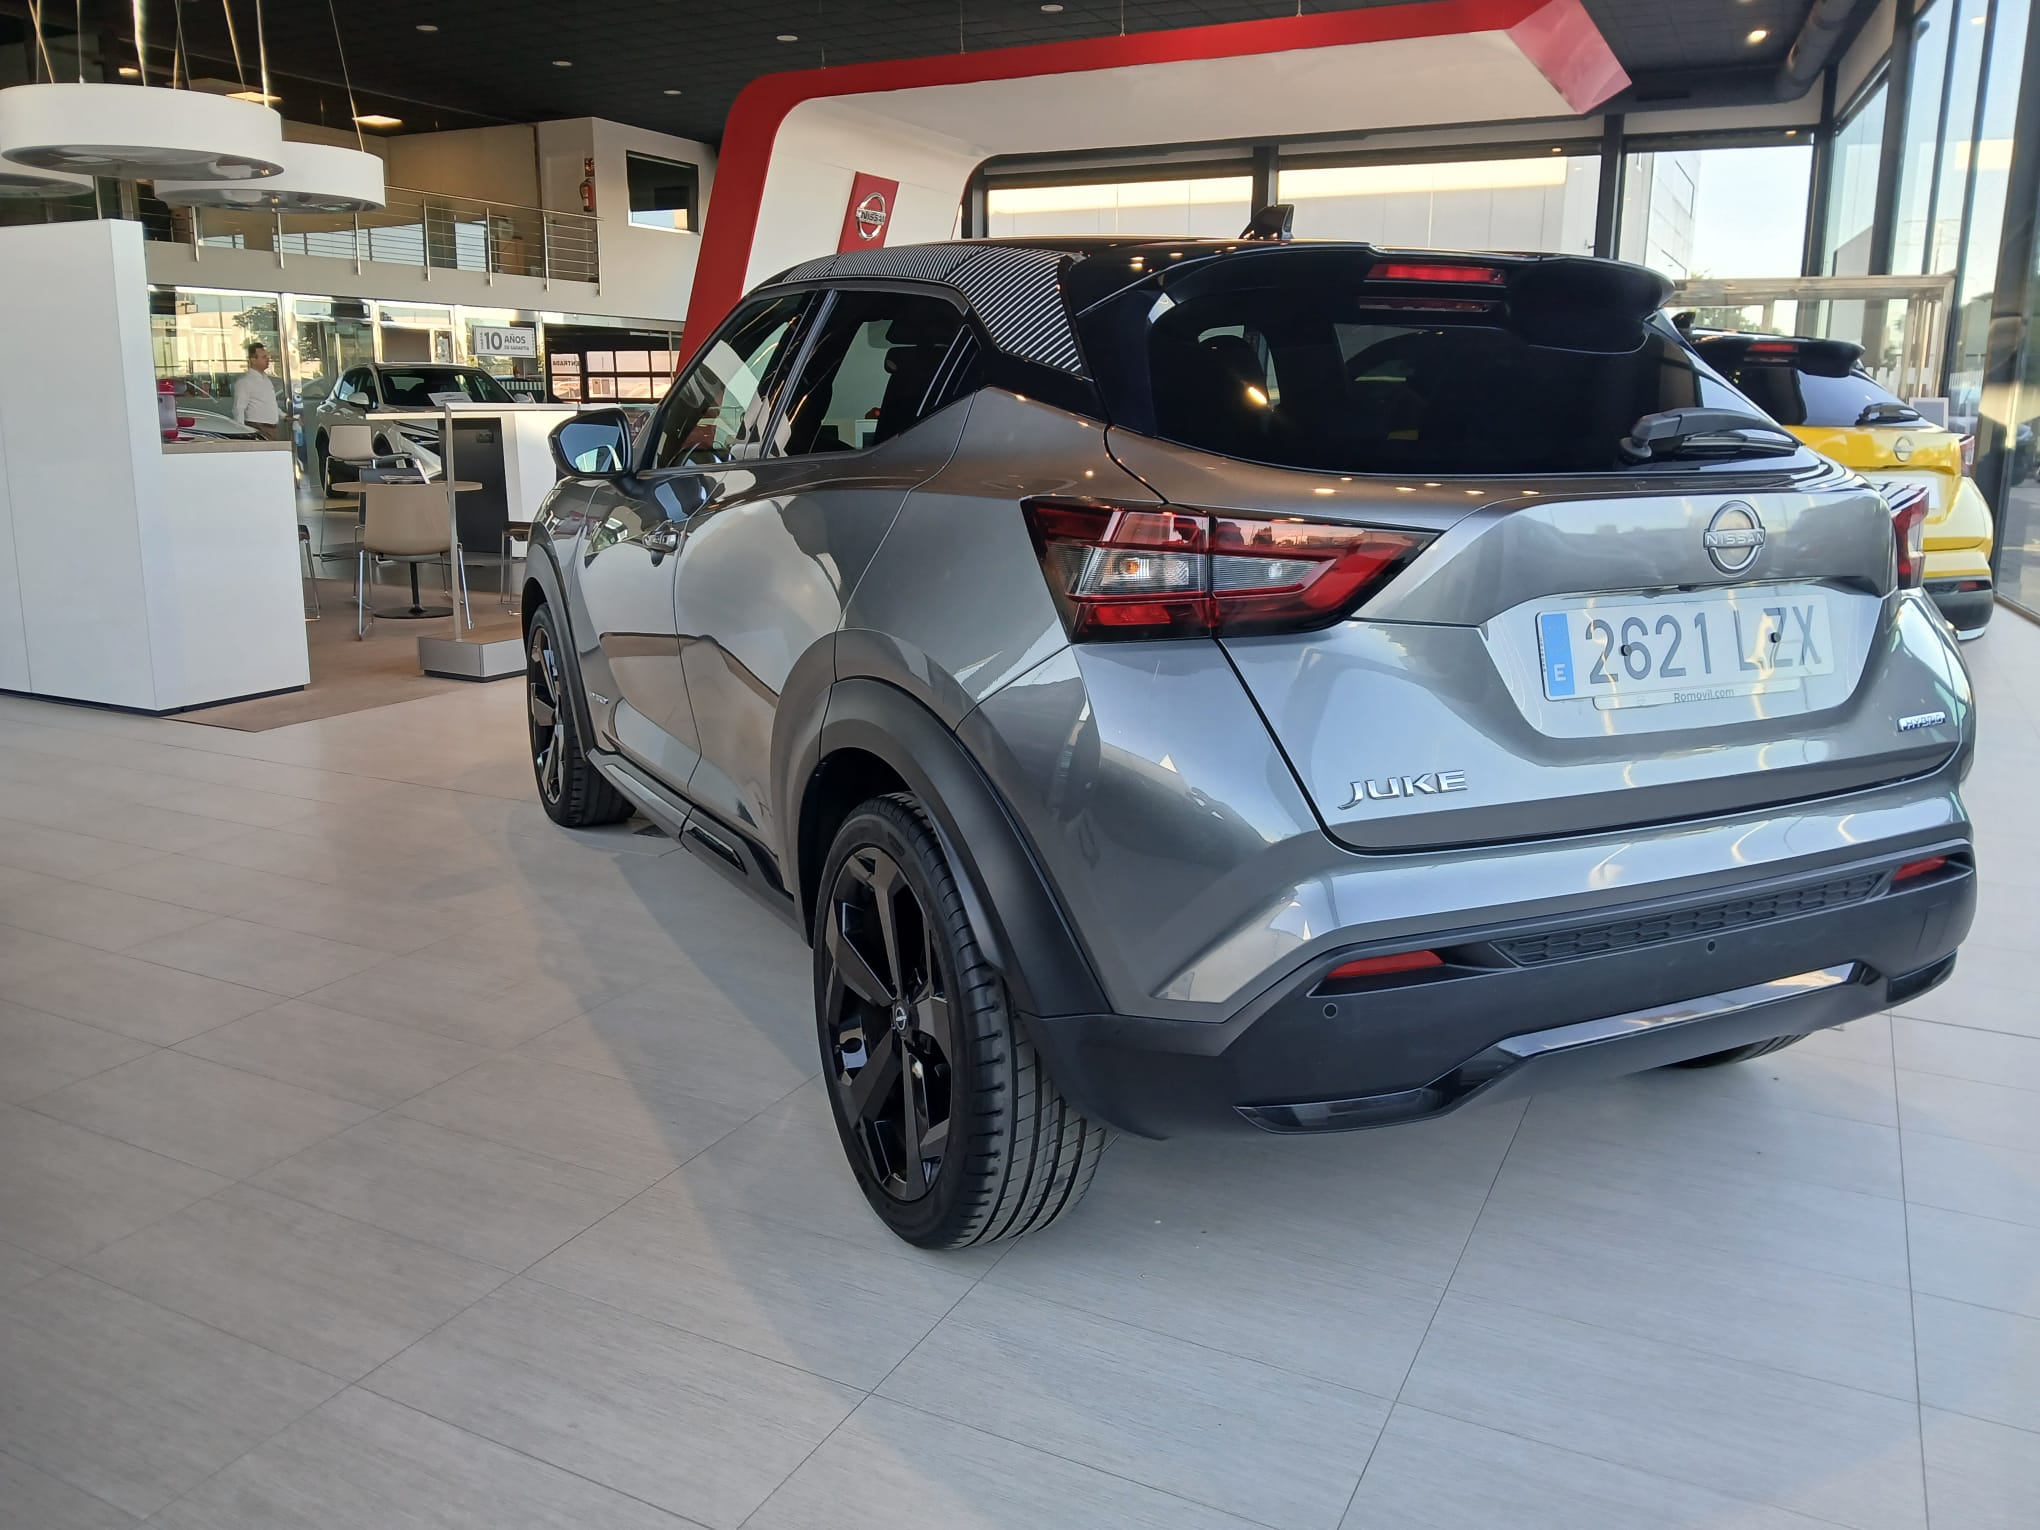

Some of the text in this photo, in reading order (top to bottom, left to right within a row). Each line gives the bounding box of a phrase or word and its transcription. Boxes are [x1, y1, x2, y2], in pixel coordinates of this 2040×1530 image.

[484, 331, 503, 351] 10
[504, 333, 526, 344] AÑOS
[1706, 530, 1764, 546] NISSAN
[1585, 612, 1712, 684] 2621
[1732, 605, 1822, 672] LZX
[1553, 663, 1568, 682] E
[1673, 688, 1735, 703] Romovil.com
[1337, 769, 1469, 810] JUKE
